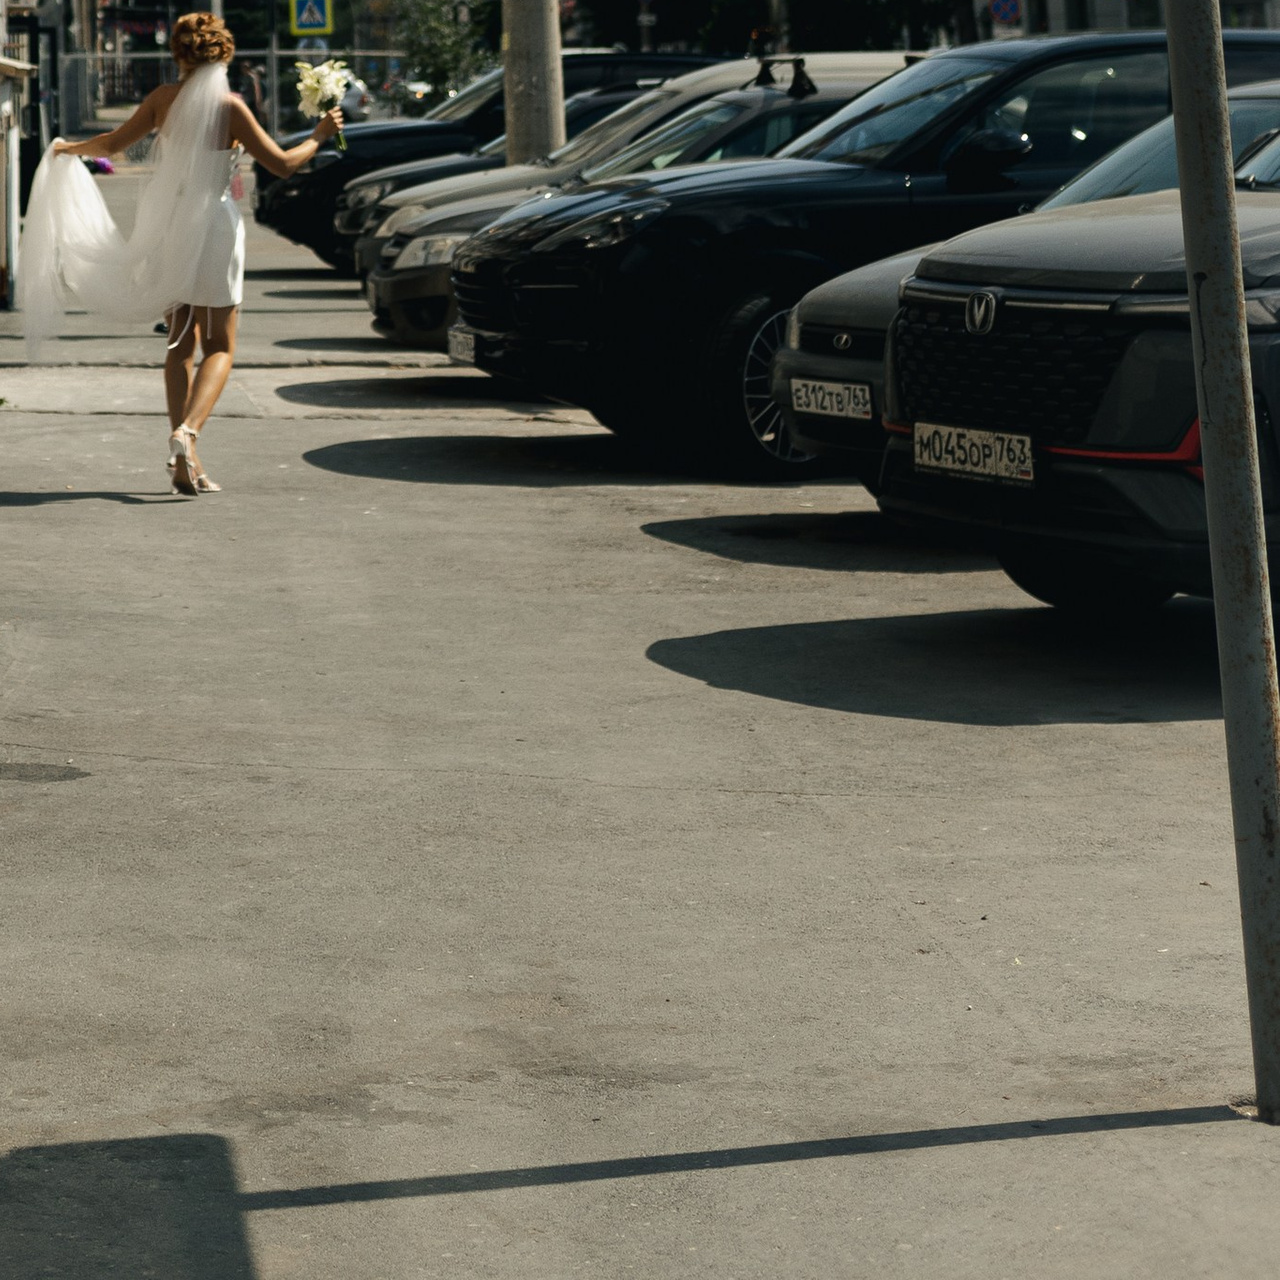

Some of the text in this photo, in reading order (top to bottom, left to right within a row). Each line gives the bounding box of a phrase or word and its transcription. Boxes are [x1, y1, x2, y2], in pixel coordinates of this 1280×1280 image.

[844, 386, 869, 407] 763
[919, 429, 1027, 470] М045ОР 763
